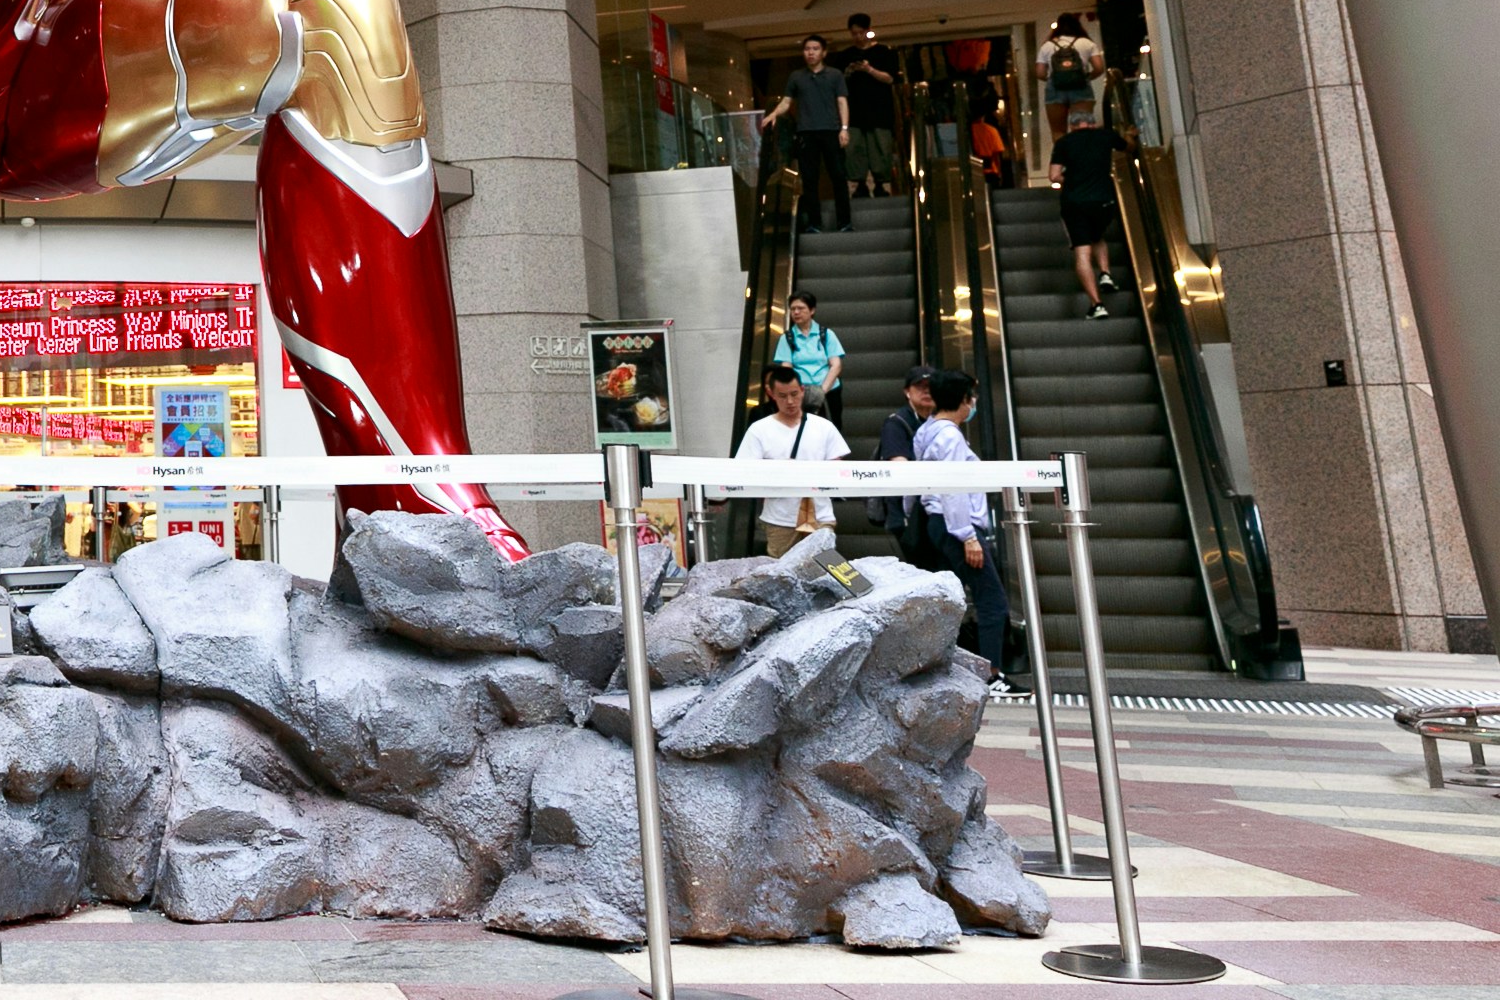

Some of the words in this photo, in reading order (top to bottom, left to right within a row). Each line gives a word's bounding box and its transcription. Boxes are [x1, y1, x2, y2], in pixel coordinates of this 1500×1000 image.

[51, 316, 117, 336] Princess
[171, 309, 228, 331] Minions
[89, 332, 119, 352] Line
[126, 329, 183, 351] Friends
[152, 466, 185, 477] Hysan
[401, 464, 432, 475] Hysan
[852, 469, 877, 479] Hysan
[1038, 470, 1061, 479] Hysan
[201, 524, 220, 534] UNI
